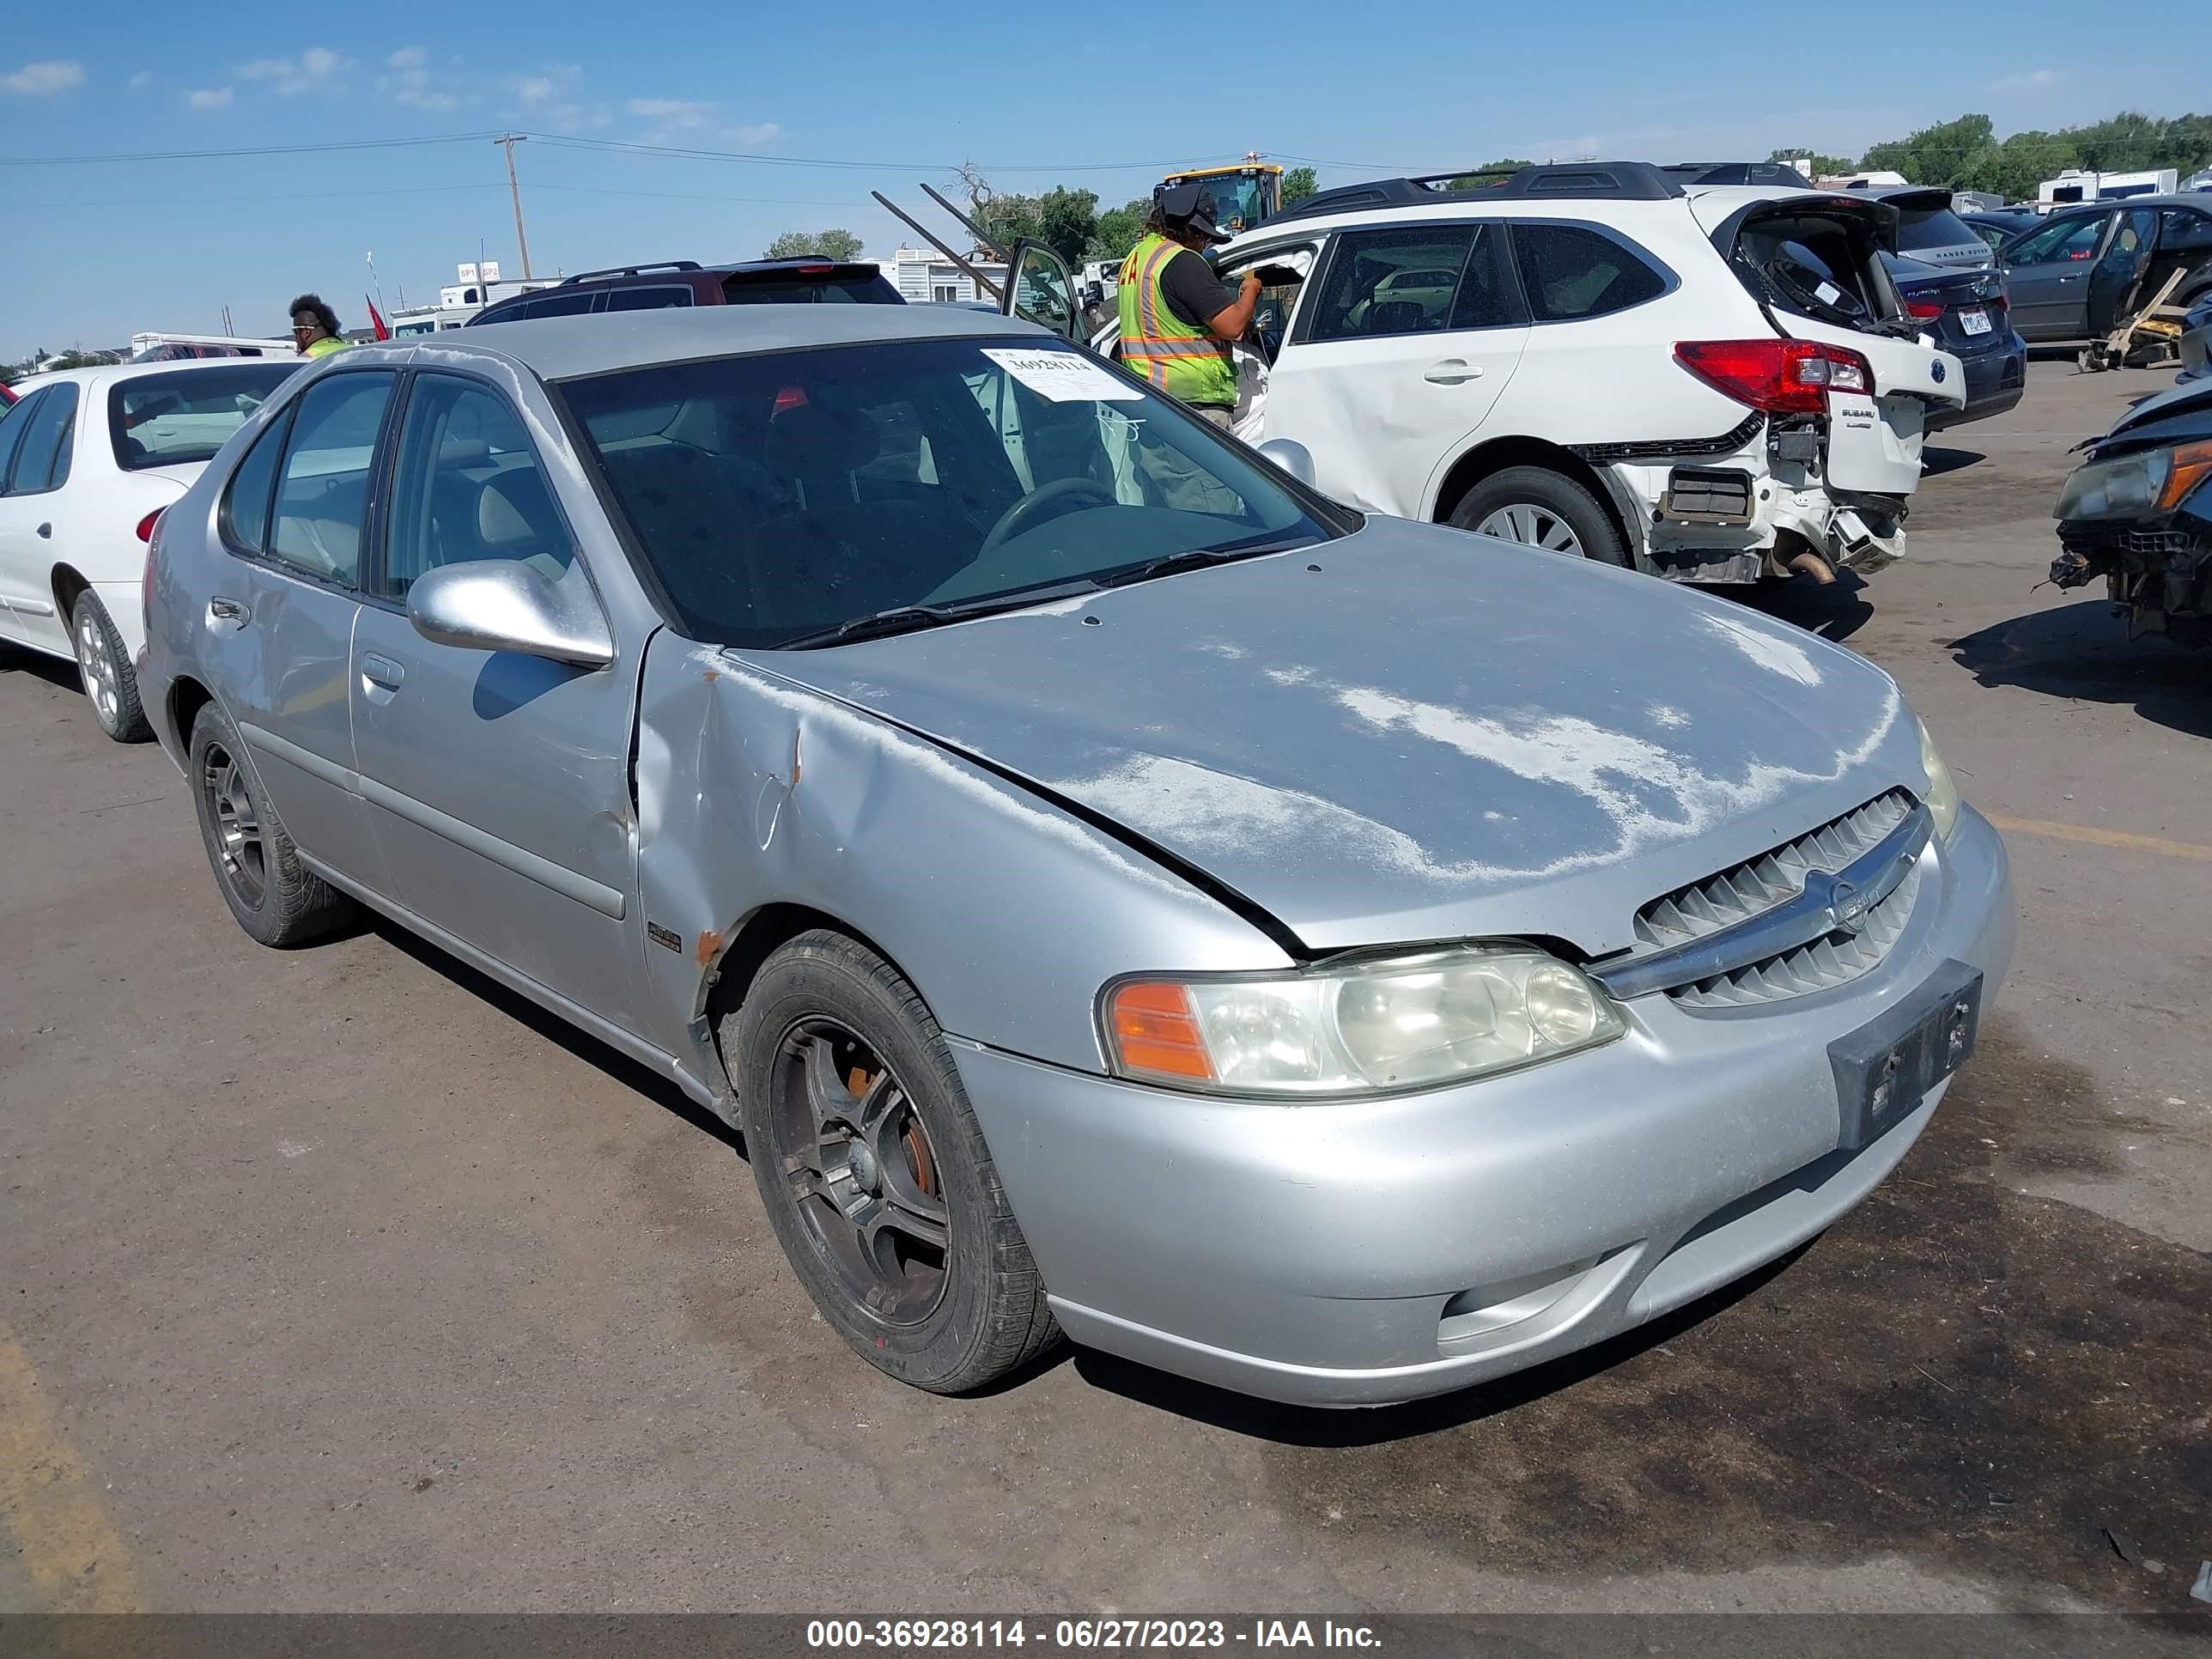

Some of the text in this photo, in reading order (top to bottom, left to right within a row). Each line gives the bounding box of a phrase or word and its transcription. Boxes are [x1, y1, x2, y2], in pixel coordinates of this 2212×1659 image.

[460, 269, 475, 277] SP1
[483, 267, 498, 276] SP2
[1008, 359, 1092, 372] 36928114
[1841, 409, 1875, 418] SUBARU
